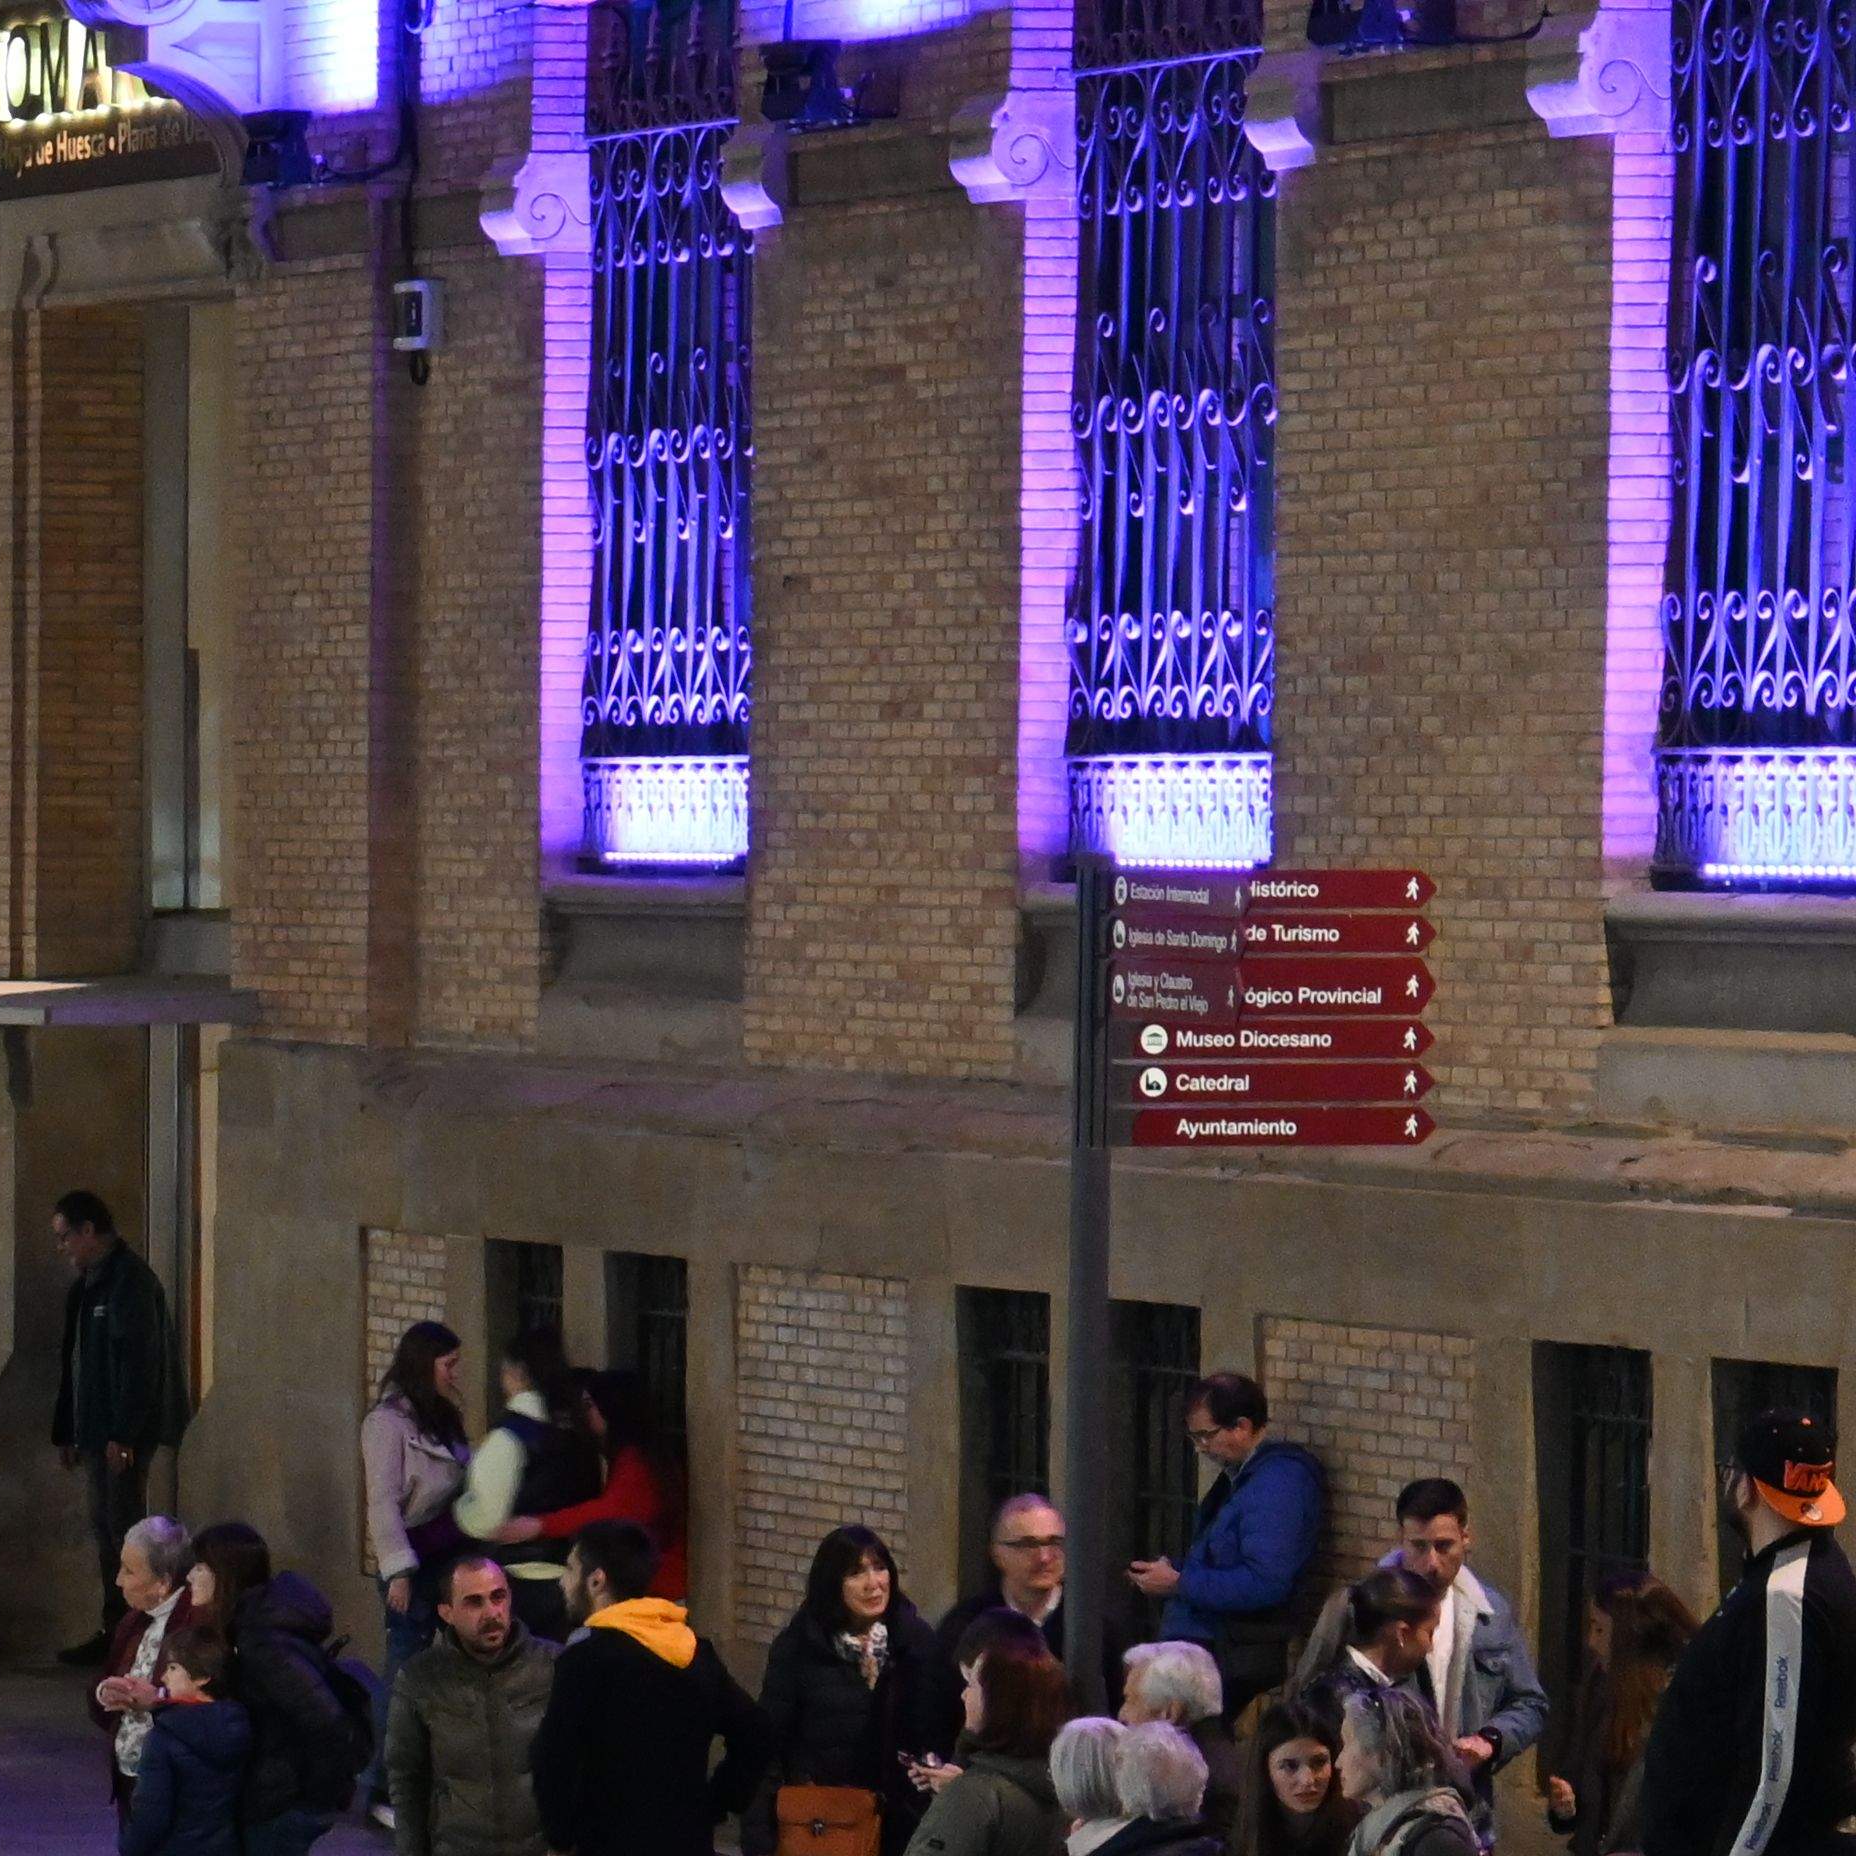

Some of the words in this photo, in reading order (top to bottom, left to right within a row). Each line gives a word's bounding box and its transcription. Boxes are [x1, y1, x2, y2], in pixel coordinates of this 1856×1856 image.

[56, 130, 106, 165] Huesca
[1130, 883, 1164, 901] Estación
[1128, 927, 1153, 948] Iglesia
[1155, 930, 1166, 946] de
[1191, 931, 1228, 954] Domingo
[1245, 925, 1267, 942] de
[1271, 924, 1340, 942] Turismo
[1138, 992, 1154, 1009] San
[1155, 993, 1179, 1011] Pedro
[1188, 995, 1209, 1016] Viejo
[1245, 987, 1293, 1008] ógico
[1298, 986, 1382, 1004] Provincial
[1176, 1030, 1236, 1048] Museo
[1239, 1029, 1332, 1048] Diocesano
[1175, 1073, 1250, 1092] Catedral
[1176, 1118, 1297, 1139] Ayuntamiento
[1774, 1656, 1789, 1708] Reebok
